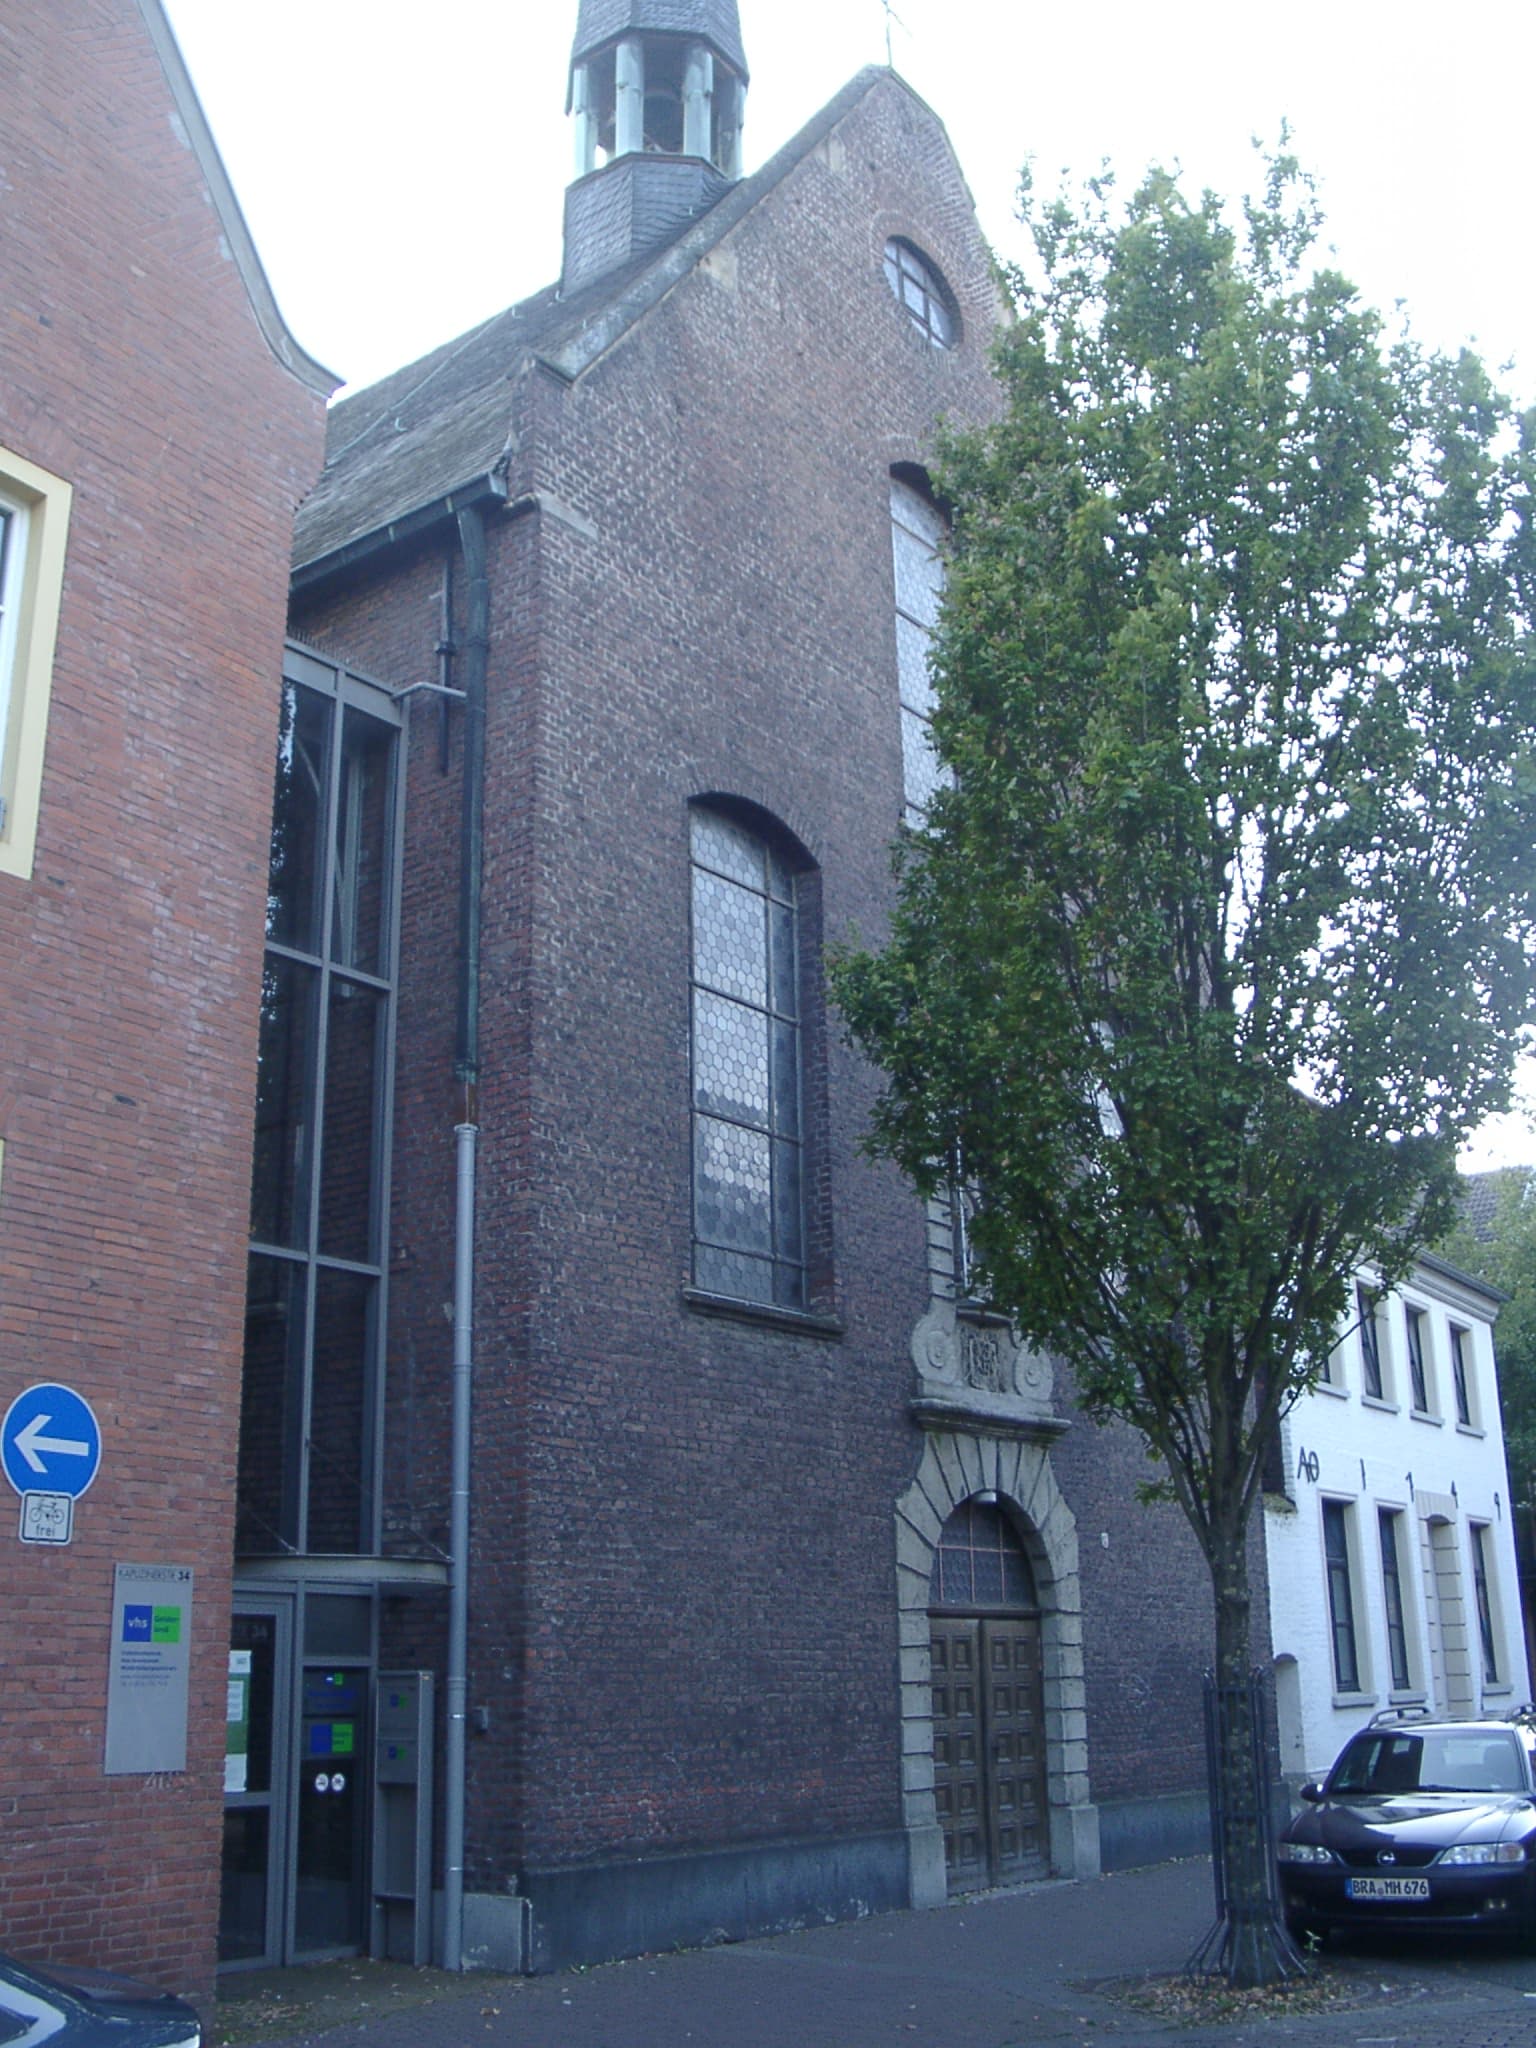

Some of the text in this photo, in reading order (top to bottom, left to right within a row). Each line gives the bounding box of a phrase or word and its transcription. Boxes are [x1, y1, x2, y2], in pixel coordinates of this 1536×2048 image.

[35, 1523, 56, 1537] frei
[177, 1570, 190, 1581] 34
[127, 1616, 148, 1629] vhs
[1353, 1879, 1428, 1895] BRA MH 676
